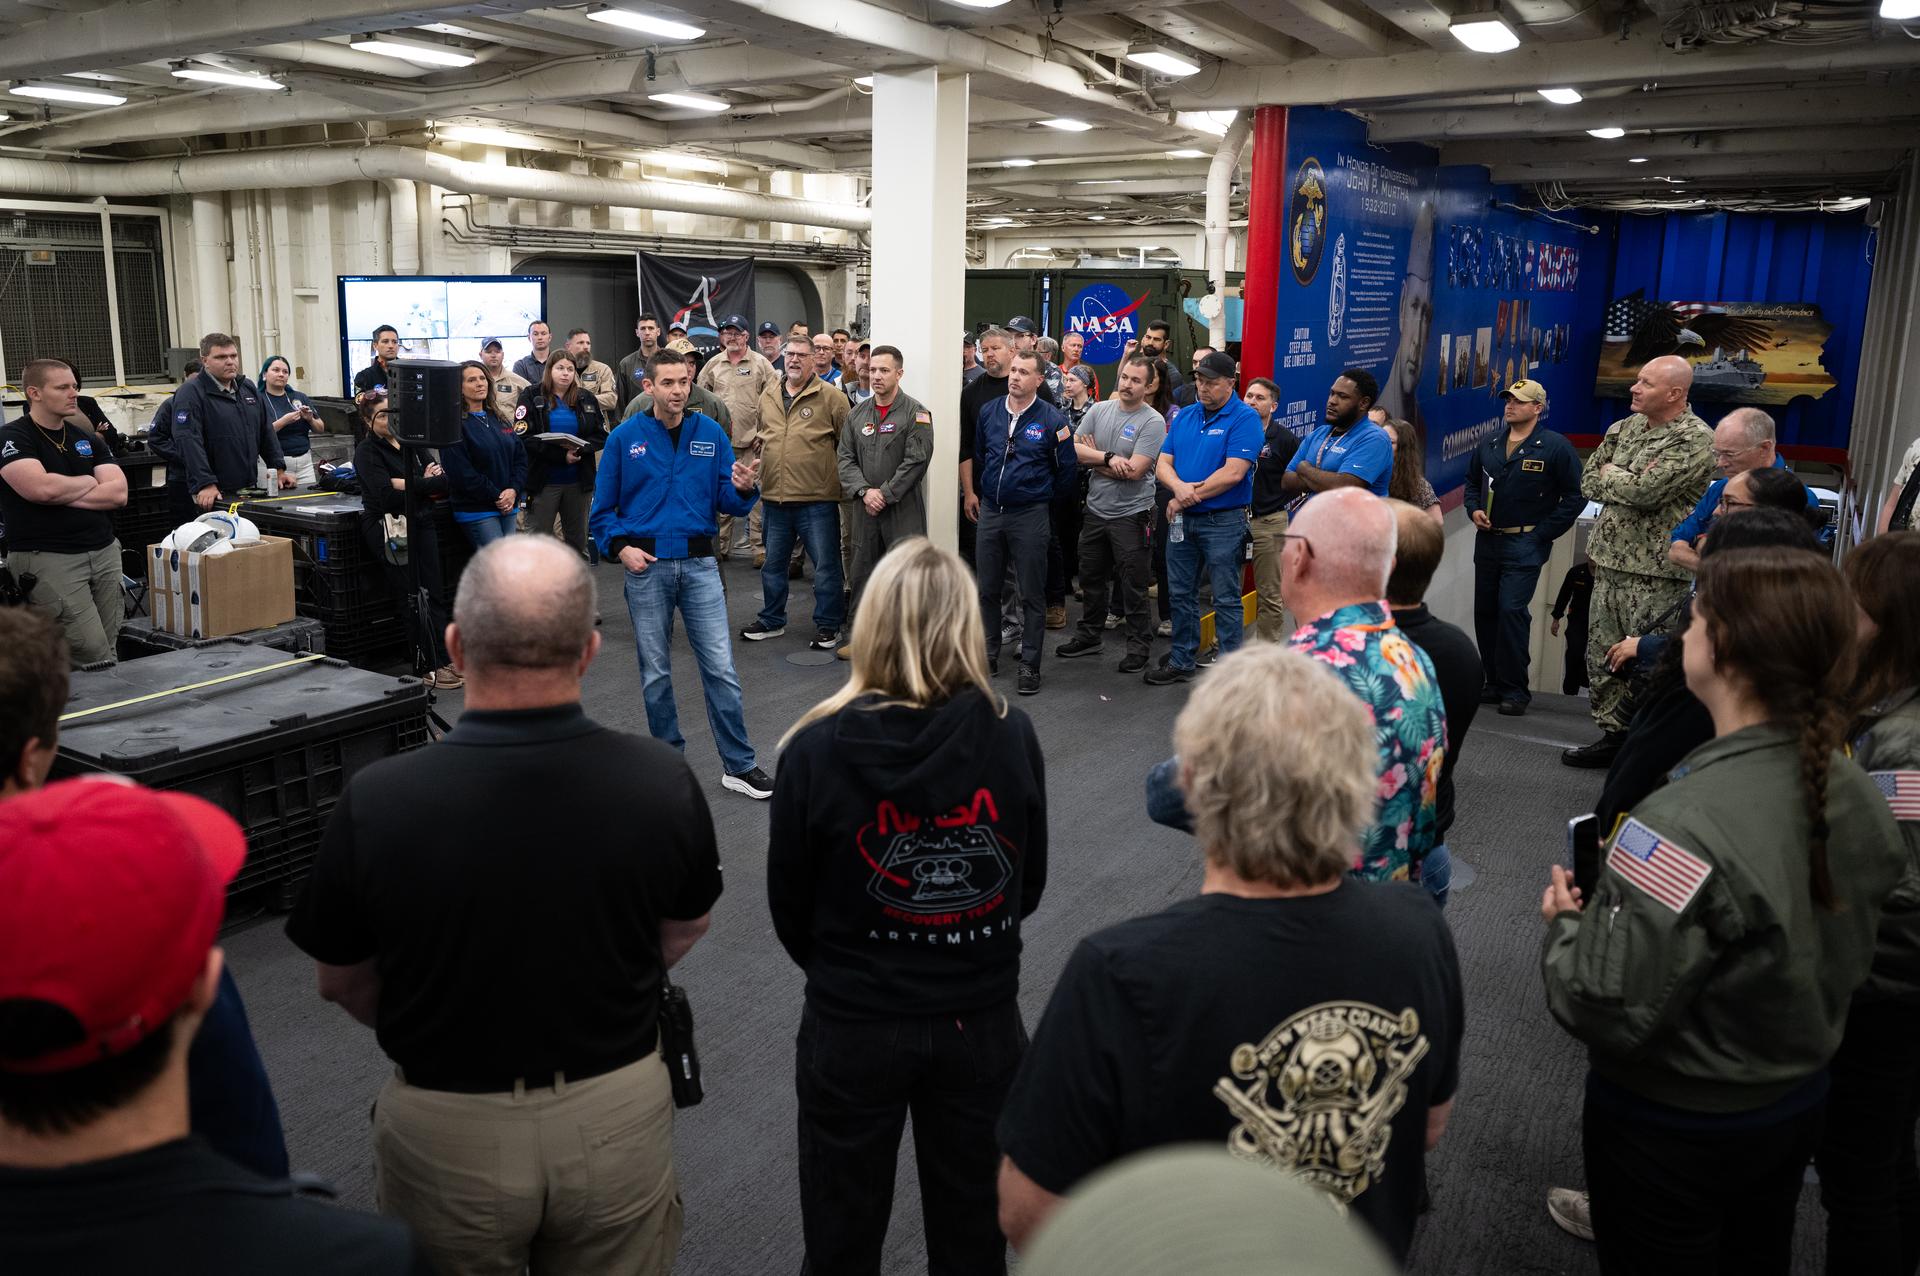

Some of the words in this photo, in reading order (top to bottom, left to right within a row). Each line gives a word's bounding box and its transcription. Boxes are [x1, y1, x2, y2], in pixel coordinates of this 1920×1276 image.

[1346, 155, 1369, 171] HONOR
[1380, 165, 1418, 187] CONGRESSMAN
[1347, 174, 1369, 192] JOHN
[1371, 180, 1379, 194] P.
[1381, 182, 1409, 201] MURTHA
[1361, 197, 1397, 216] 1932-2010
[1070, 316, 1134, 333] NASA
[1027, 429, 1042, 438] NASA
[629, 446, 646, 454] NASA
[882, 905, 962, 926] RECOVERY
[868, 926, 993, 945] ARTEMIS
[1001, 916, 1012, 931] II
[1347, 1008, 1399, 1039] COAST
